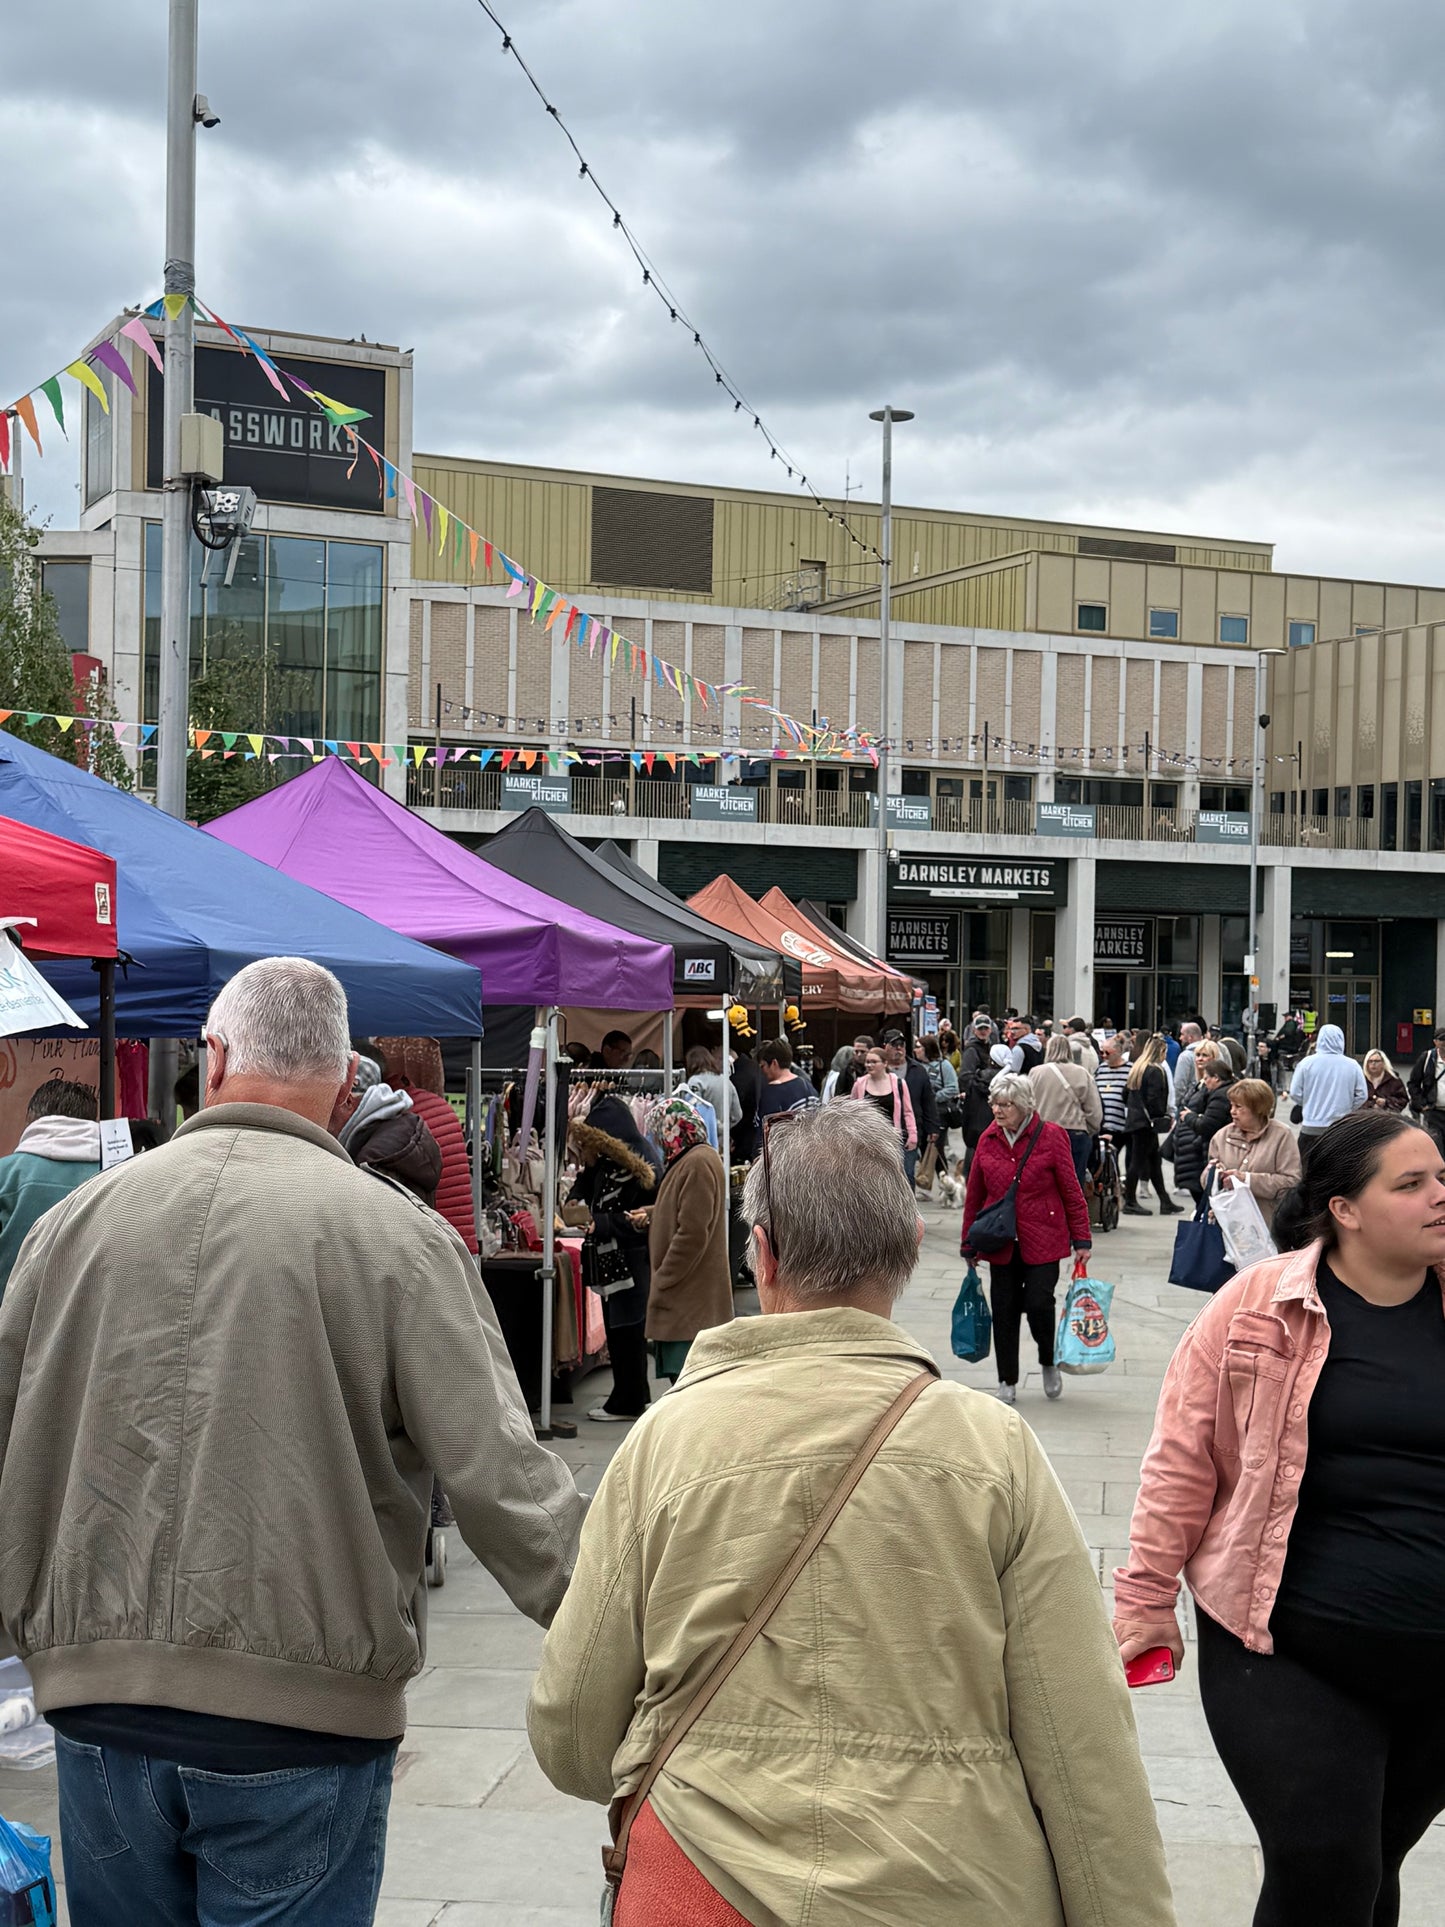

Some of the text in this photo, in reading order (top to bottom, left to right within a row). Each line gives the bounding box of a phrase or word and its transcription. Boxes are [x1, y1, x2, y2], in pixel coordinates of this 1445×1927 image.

[505, 777, 542, 790] MARKET
[531, 790, 568, 802] KITCHEN
[695, 787, 731, 799] MARKET
[719, 799, 754, 811] KITCHEN
[873, 796, 906, 808] MRKET
[896, 809, 928, 820] KITCHEN
[1041, 805, 1072, 817] MARKET
[1062, 816, 1093, 828] KITCHEN
[1199, 812, 1228, 823] MARKET
[1219, 823, 1249, 835] KITCHEN
[899, 864, 1050, 886] BARNSLEY MARKETS
[890, 921, 949, 935] BARNSLEY
[1096, 926, 1144, 940] ARNSLEY
[890, 935, 949, 950] MARKETS
[687, 962, 712, 974] ABC
